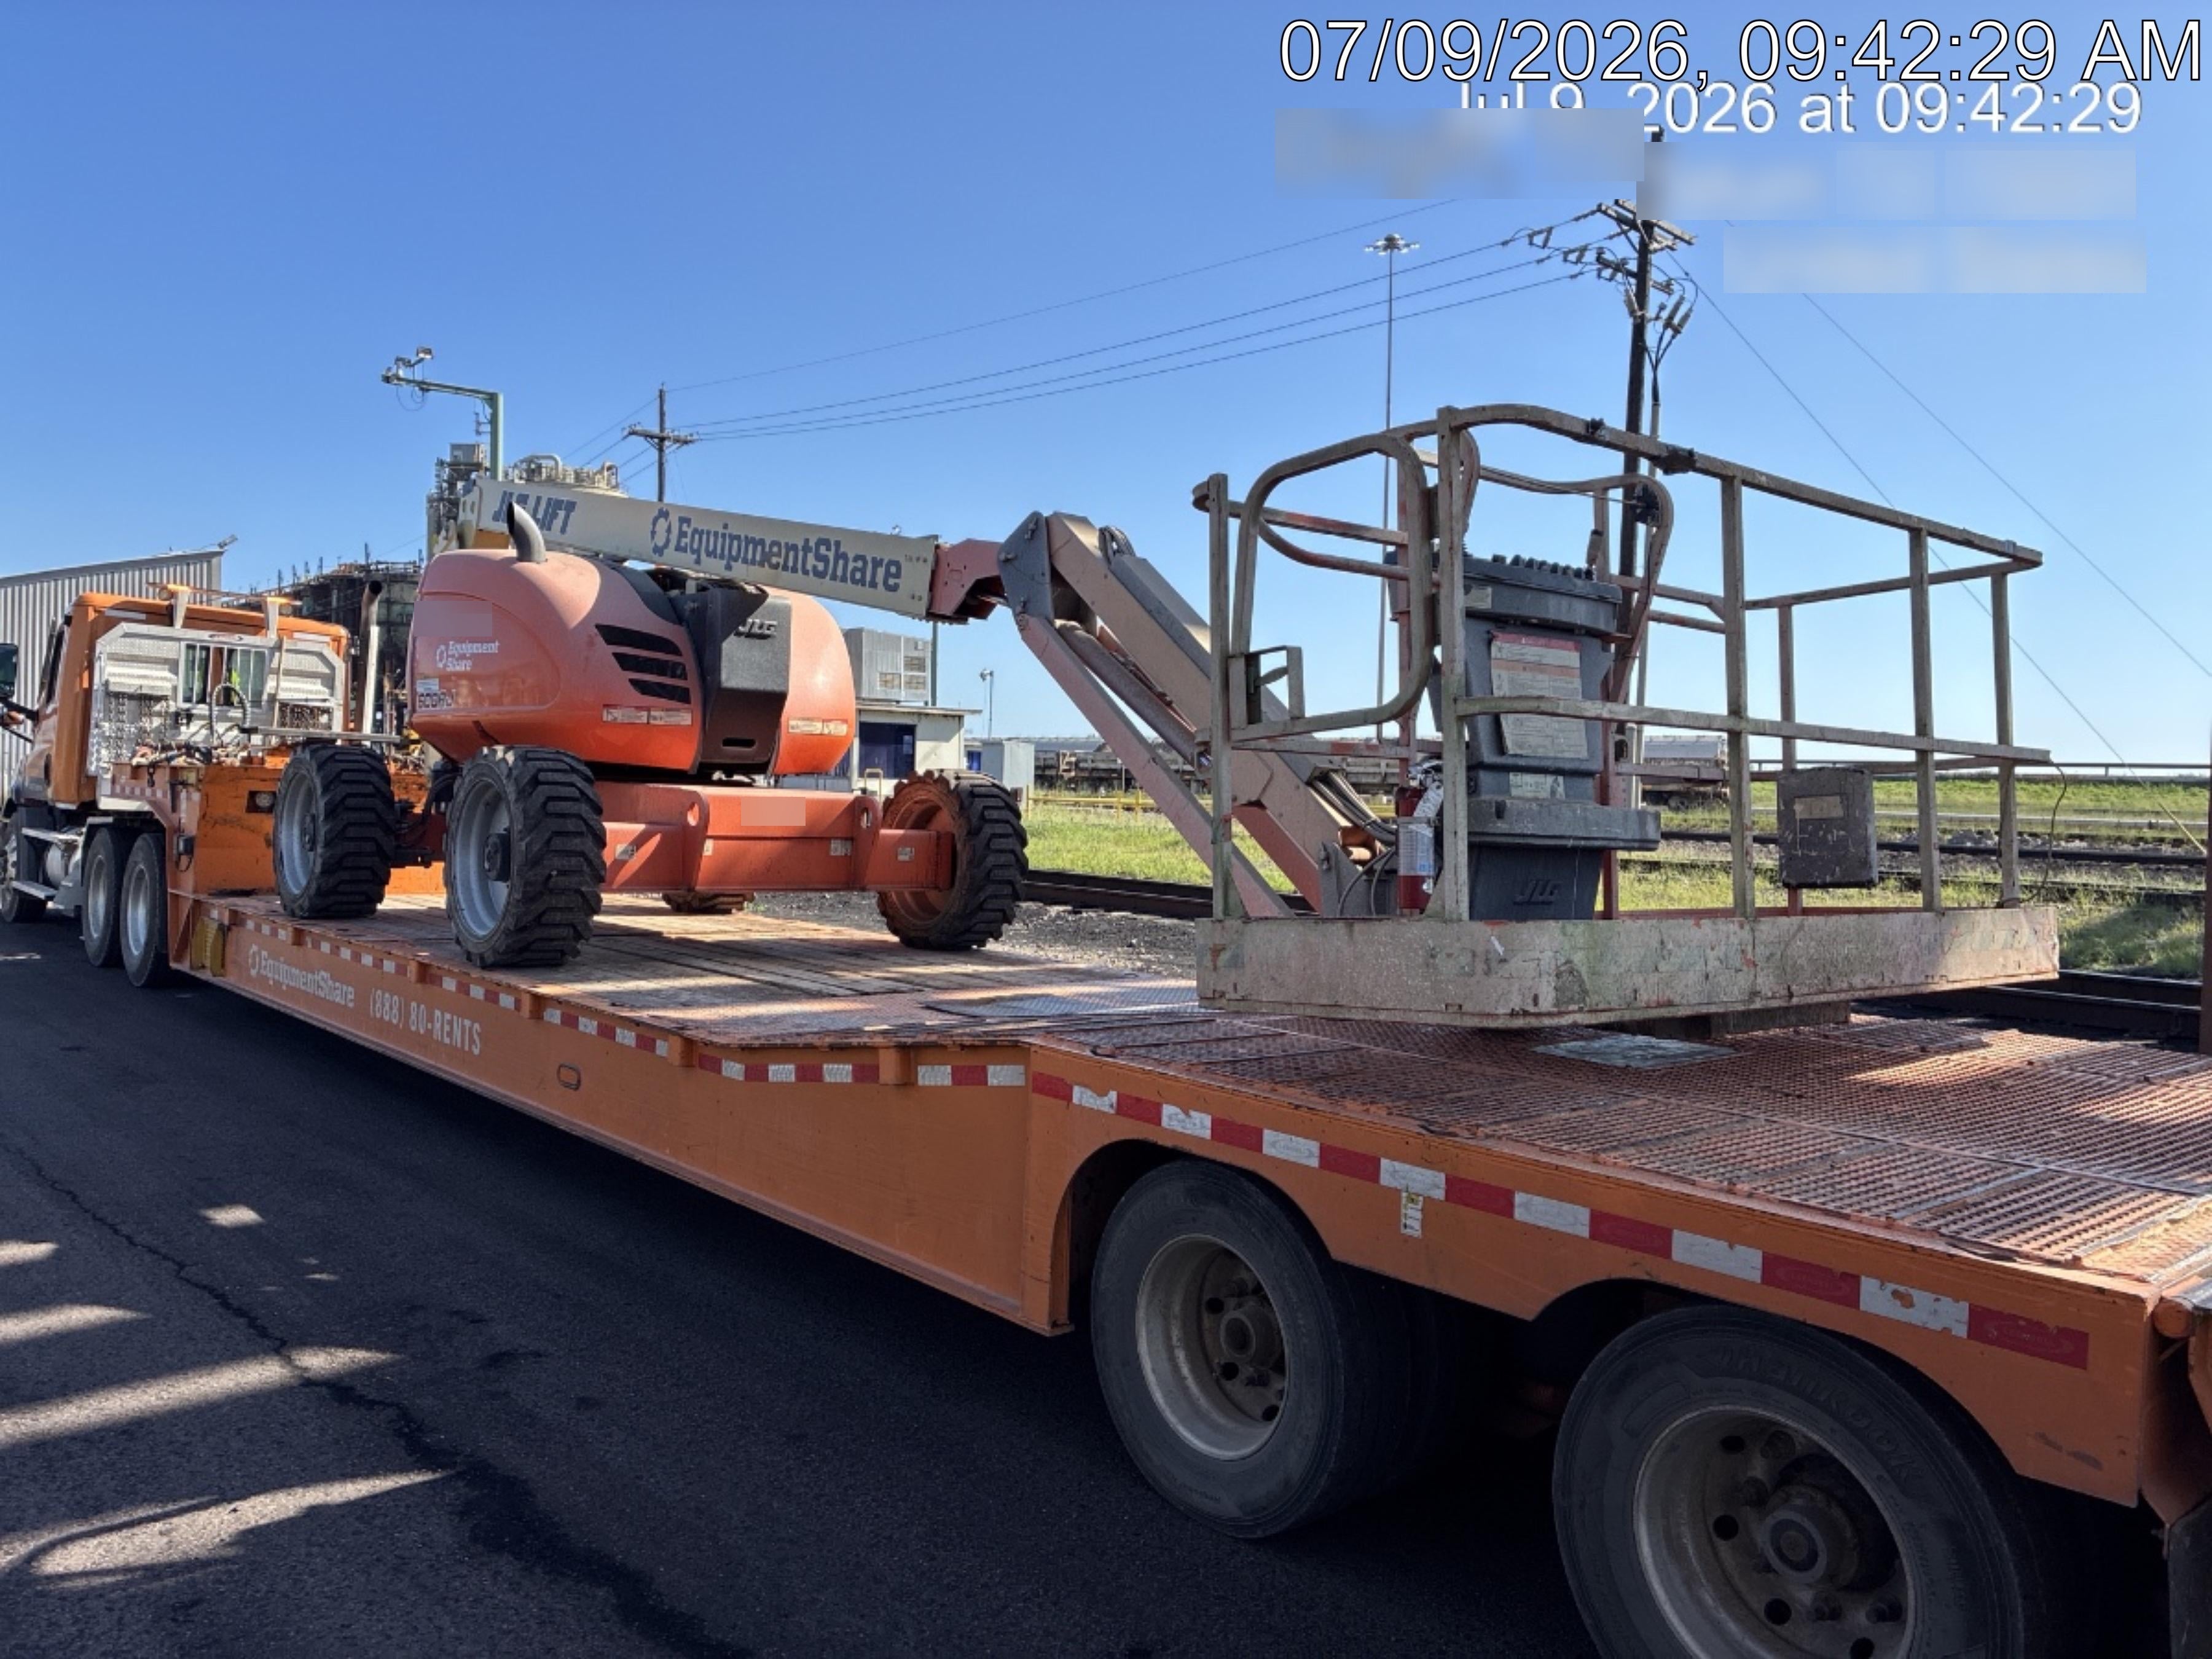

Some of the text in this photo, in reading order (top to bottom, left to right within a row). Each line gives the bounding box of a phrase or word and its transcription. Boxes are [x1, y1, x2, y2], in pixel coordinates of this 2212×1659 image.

[531, 495, 578, 536] LIFT
[674, 516, 903, 593] EquipmentShare
[446, 657, 473, 672] Share
[448, 640, 500, 657] Equipment
[260, 950, 355, 1008] EquipmentShare
[370, 987, 482, 1056] (888) 80-RENTS
